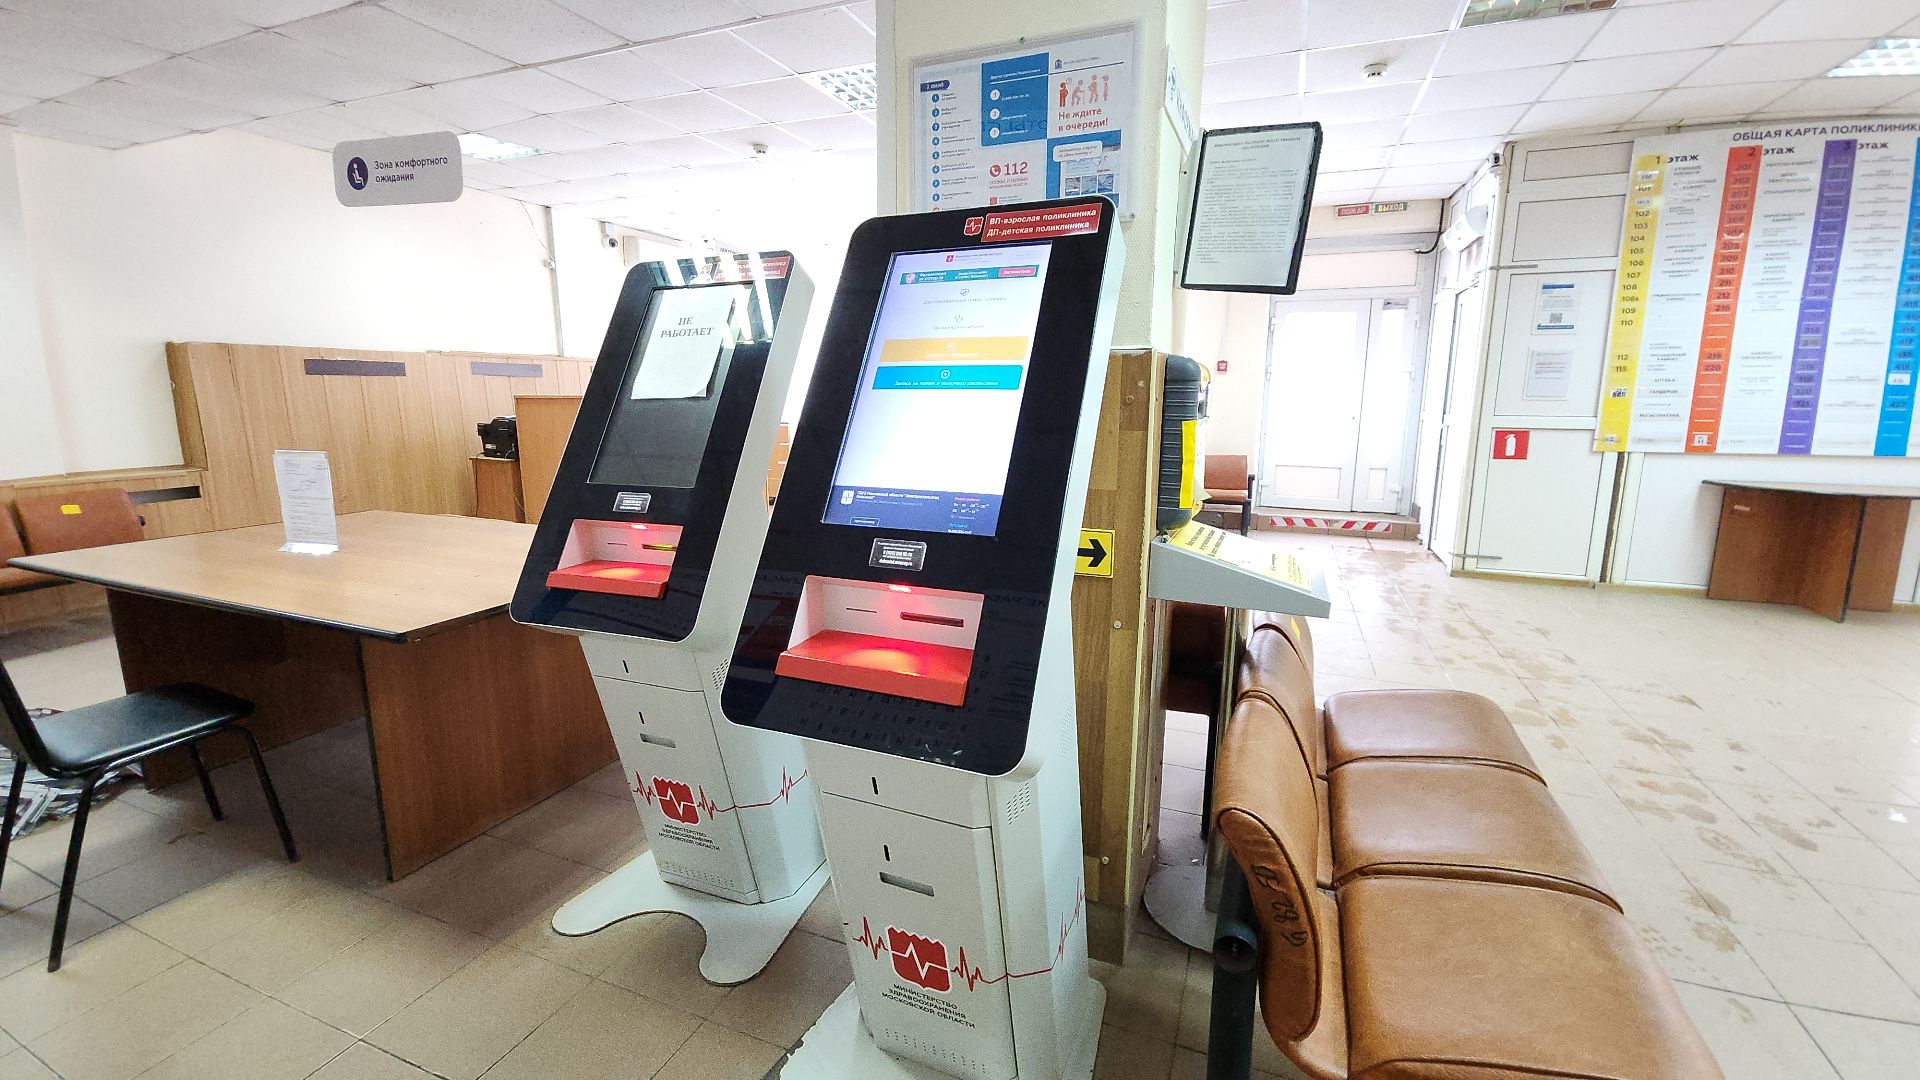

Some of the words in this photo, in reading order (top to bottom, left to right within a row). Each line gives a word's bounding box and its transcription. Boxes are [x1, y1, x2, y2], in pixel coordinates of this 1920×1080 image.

[1058, 111, 1071, 120] Не
[1073, 107, 1103, 119] ждите
[1065, 117, 1109, 132] очереди!
[1732, 129, 1782, 143] ОБЩАЯ
[1785, 126, 1828, 138] КАРТА
[1748, 147, 1756, 157] 2
[1763, 145, 1796, 156] этаж
[1858, 140, 1889, 151] этаж
[374, 161, 393, 170] Зона
[394, 156, 449, 169] комфортного
[1655, 155, 1661, 165] 1
[1667, 153, 1700, 164] этаж
[1003, 161, 1028, 176] 112
[375, 173, 415, 184] ожидания
[1378, 203, 1404, 212] ВЫХОД
[989, 215, 1041, 225] ВП-взрослая
[1042, 210, 1097, 221] поликлиника
[986, 227, 1034, 237] ДП-детская
[1035, 221, 1090, 232] поликлиника
[678, 316, 694, 326] НЕ
[660, 326, 714, 338] РАБОТАЕТ
[664, 823, 707, 838] МИНИСТЕРСТВО
[888, 988, 967, 1019] ЗДРАВООХРАНЕНИЯ
[893, 983, 958, 1010] МИНИСТЕРСТВО
[882, 992, 935, 1015] МОСКОВСКОЙ
[937, 1010, 976, 1029] ОБЛАСТИ
